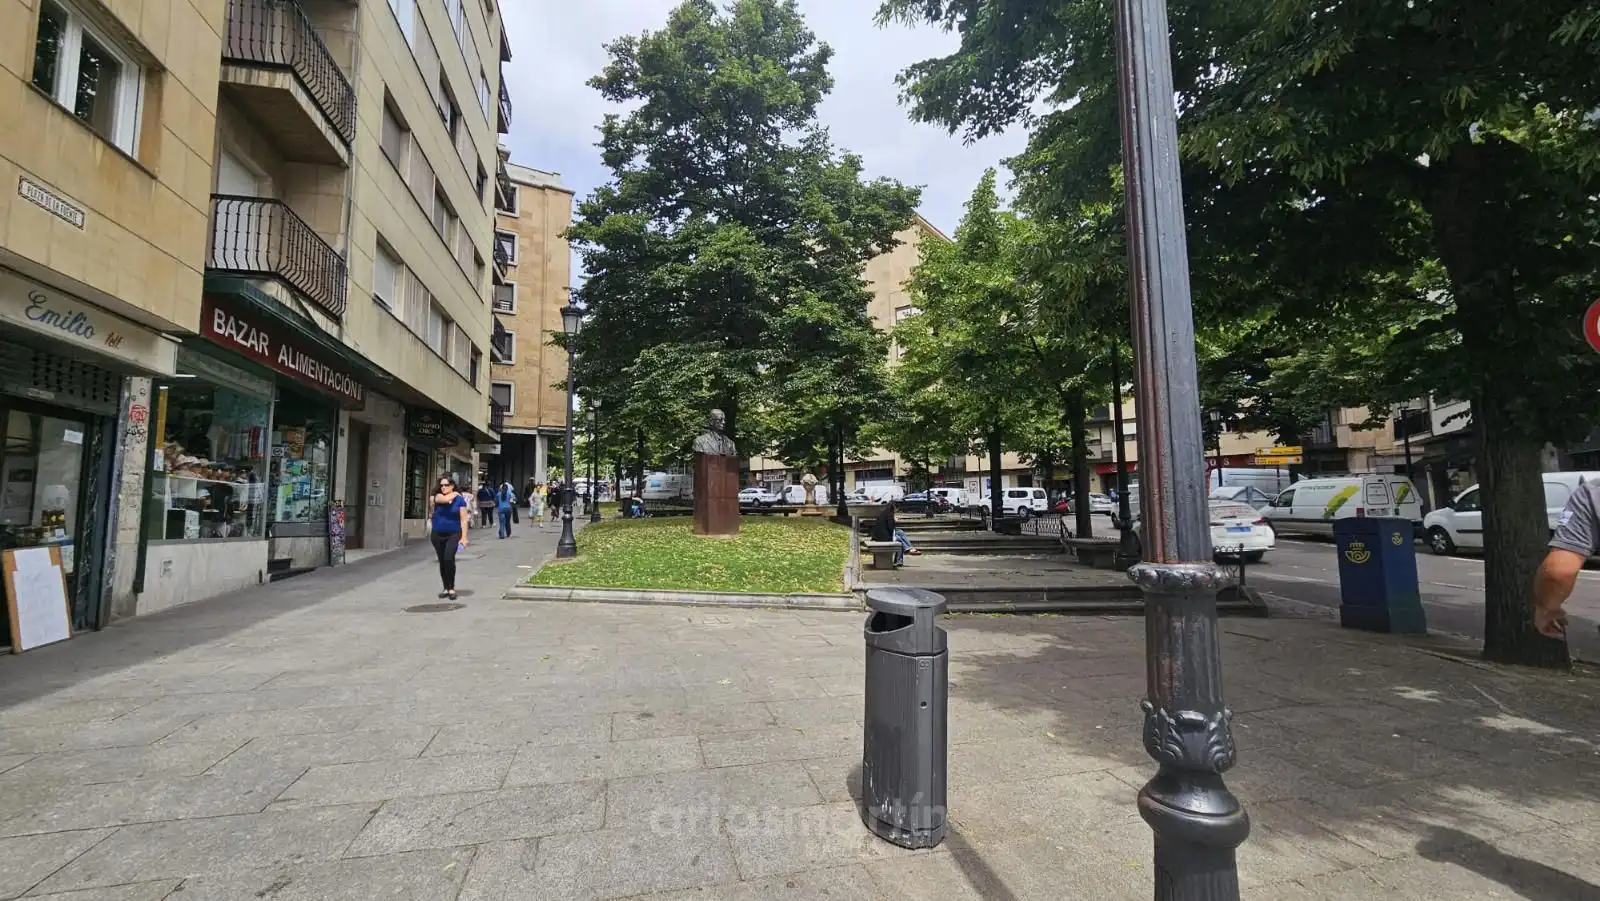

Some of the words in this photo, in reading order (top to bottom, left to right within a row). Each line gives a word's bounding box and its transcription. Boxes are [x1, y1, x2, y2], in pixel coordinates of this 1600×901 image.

[25, 290, 96, 339] Emilio
[213, 307, 269, 356] BAZAR
[278, 343, 358, 399] ALIMENTACIÓN
